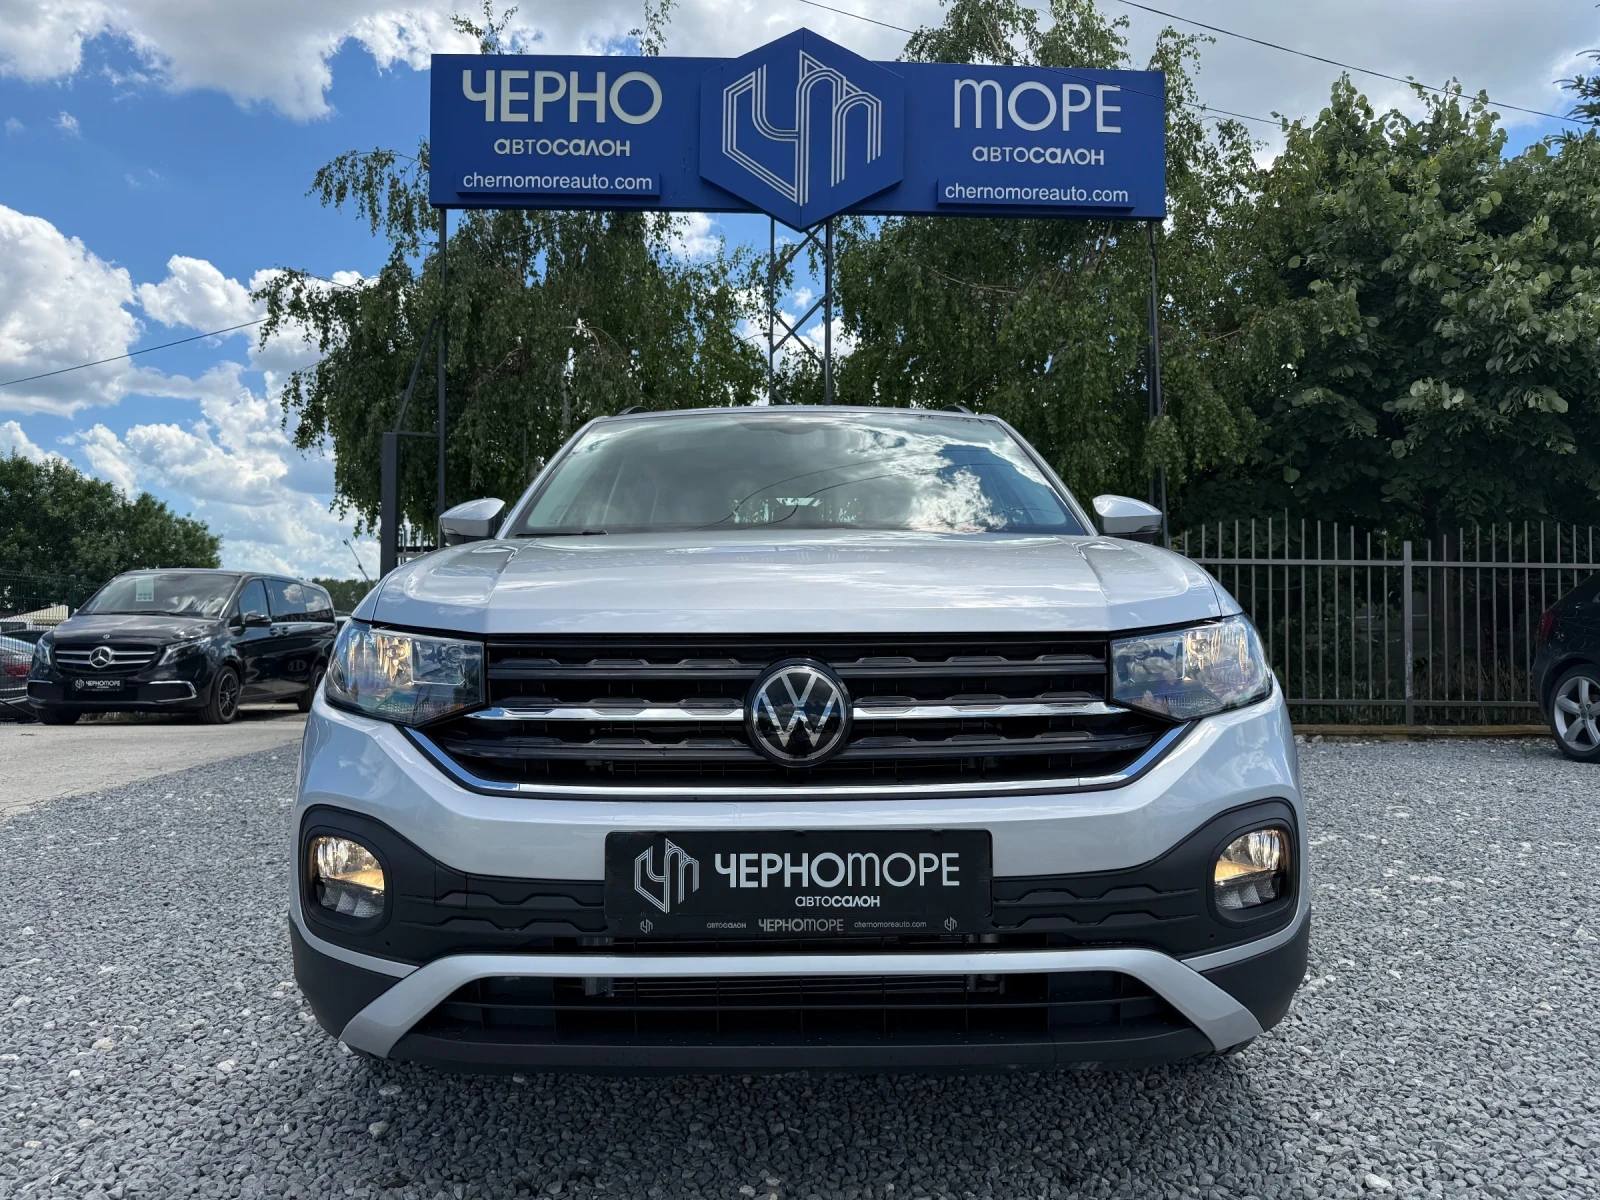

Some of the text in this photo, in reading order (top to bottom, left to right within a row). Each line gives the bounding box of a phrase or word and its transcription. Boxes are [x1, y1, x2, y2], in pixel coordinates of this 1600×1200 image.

[462, 69, 663, 125] ЧЕРНО
[463, 171, 653, 191] chernomoreauto.com
[944, 182, 1129, 203] chernomoreauto.com
[714, 852, 960, 888] ЧЕРНОМОРЕ
[758, 918, 844, 932] ЧЕРНОМОРЕ
[854, 920, 927, 928] chernomoreauto.com
